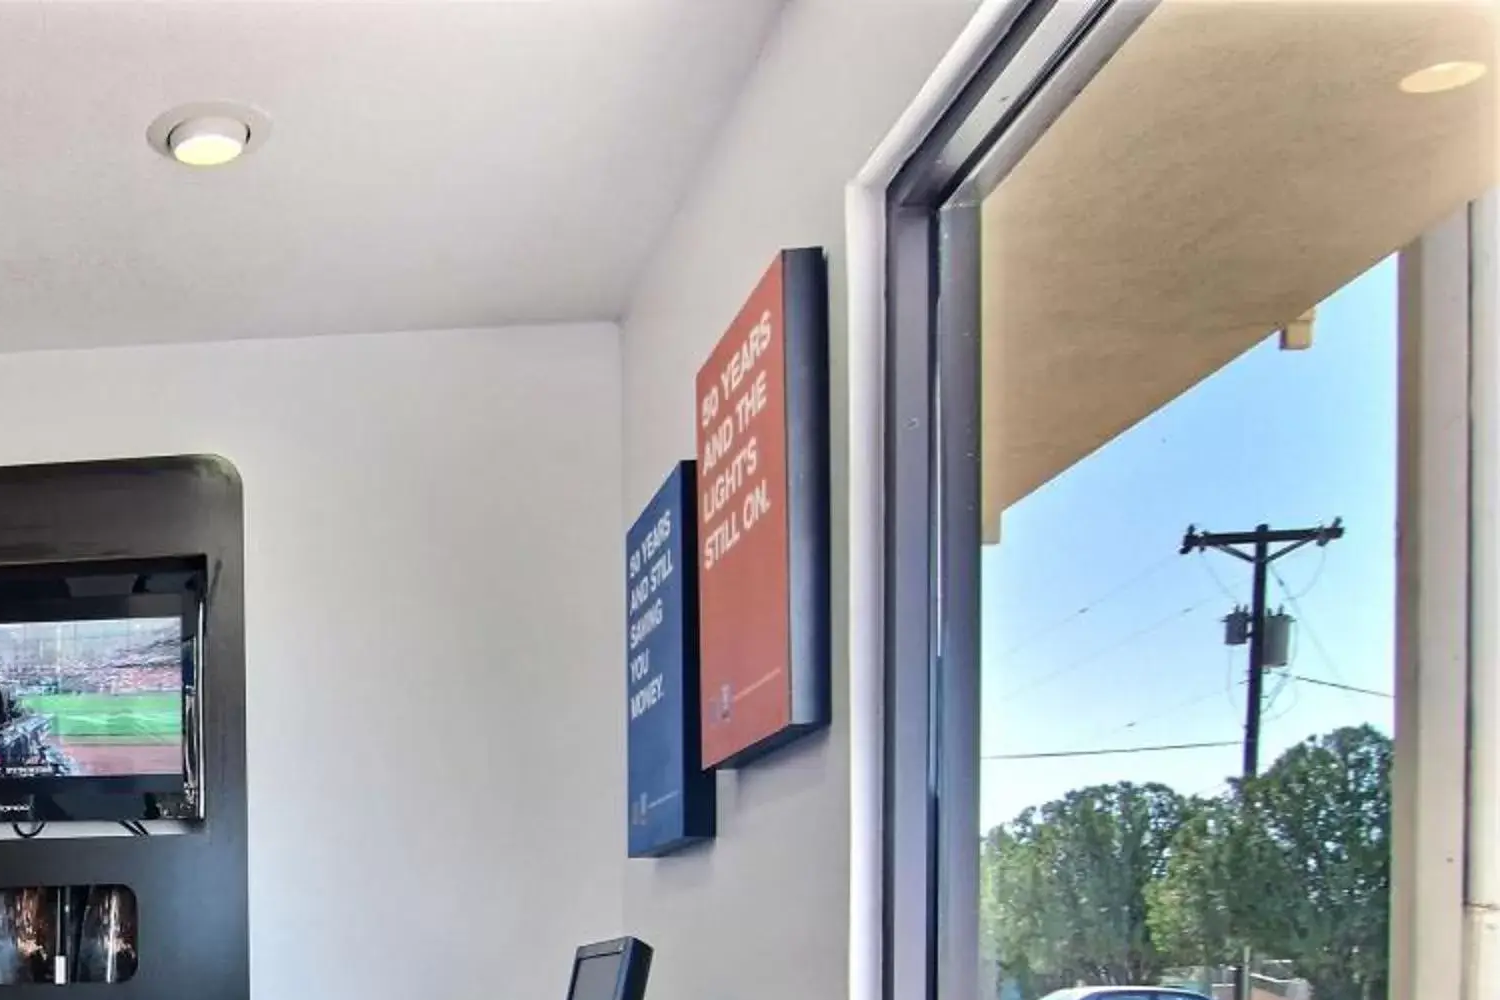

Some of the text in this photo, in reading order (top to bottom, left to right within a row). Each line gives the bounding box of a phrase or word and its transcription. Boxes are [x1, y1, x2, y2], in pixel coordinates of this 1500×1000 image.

[701, 308, 772, 428] 50 YEARS
[702, 369, 767, 477] AND THE
[641, 508, 672, 564] YEARS
[703, 479, 772, 571] STILL ON.
[629, 547, 674, 617] AND STILL
[630, 597, 664, 650] SAVING
[630, 647, 651, 684] YOU
